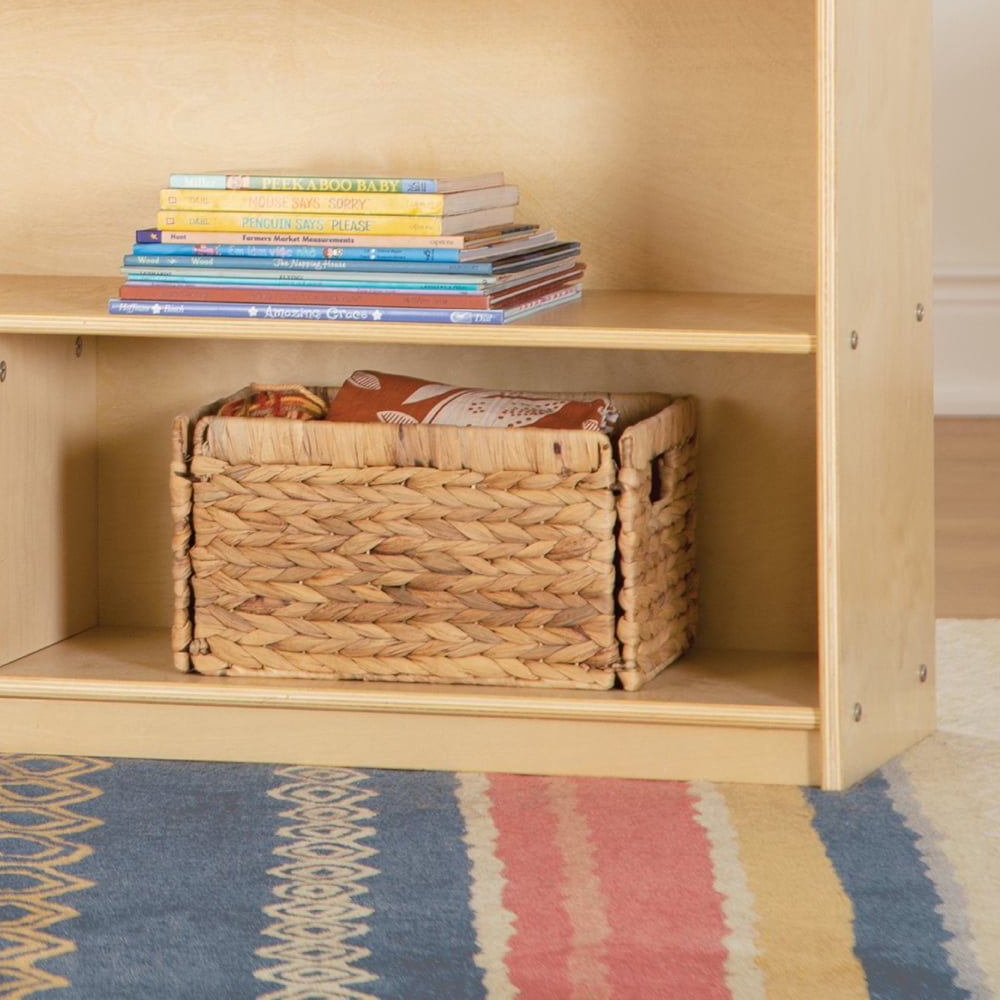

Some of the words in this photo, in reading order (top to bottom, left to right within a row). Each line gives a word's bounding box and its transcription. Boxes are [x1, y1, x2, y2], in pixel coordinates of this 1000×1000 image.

[356, 179, 399, 192] BABY
[248, 196, 288, 208] MOUSE
[291, 197, 320, 209] SAYS
[242, 217, 291, 230] PENGUIN
[295, 218, 324, 231] SAYS
[242, 234, 271, 242] Farmers
[273, 235, 300, 243] Market
[302, 236, 355, 244] Measurements
[137, 256, 160, 264] Wood
[191, 257, 214, 265] Wood
[273, 258, 289, 267] The
[322, 259, 347, 269] House
[263, 305, 321, 319] Amazing
[325, 307, 368, 320] Grace
